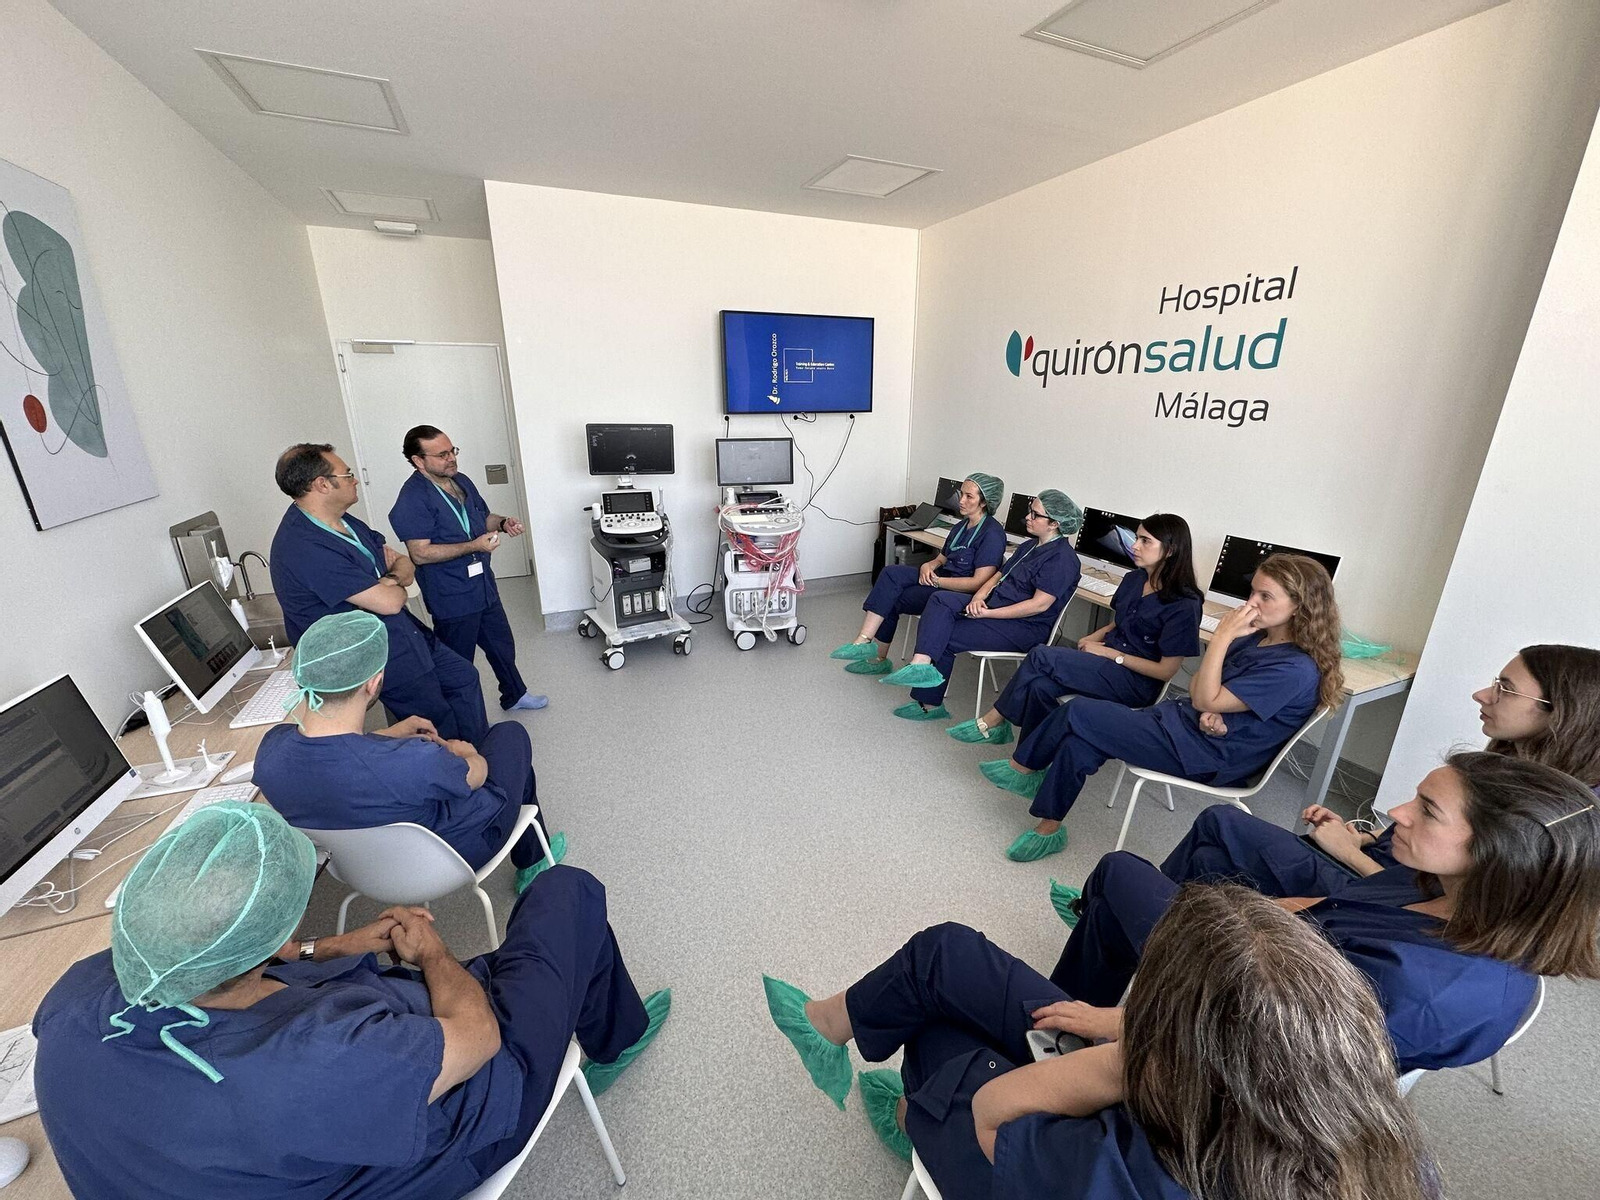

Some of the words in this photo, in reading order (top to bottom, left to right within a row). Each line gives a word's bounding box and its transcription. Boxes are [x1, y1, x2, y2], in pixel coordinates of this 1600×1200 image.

[1159, 266, 1299, 314] Hospital
[1032, 318, 1288, 388] quirónsalud
[1155, 392, 1270, 428] Málaga
